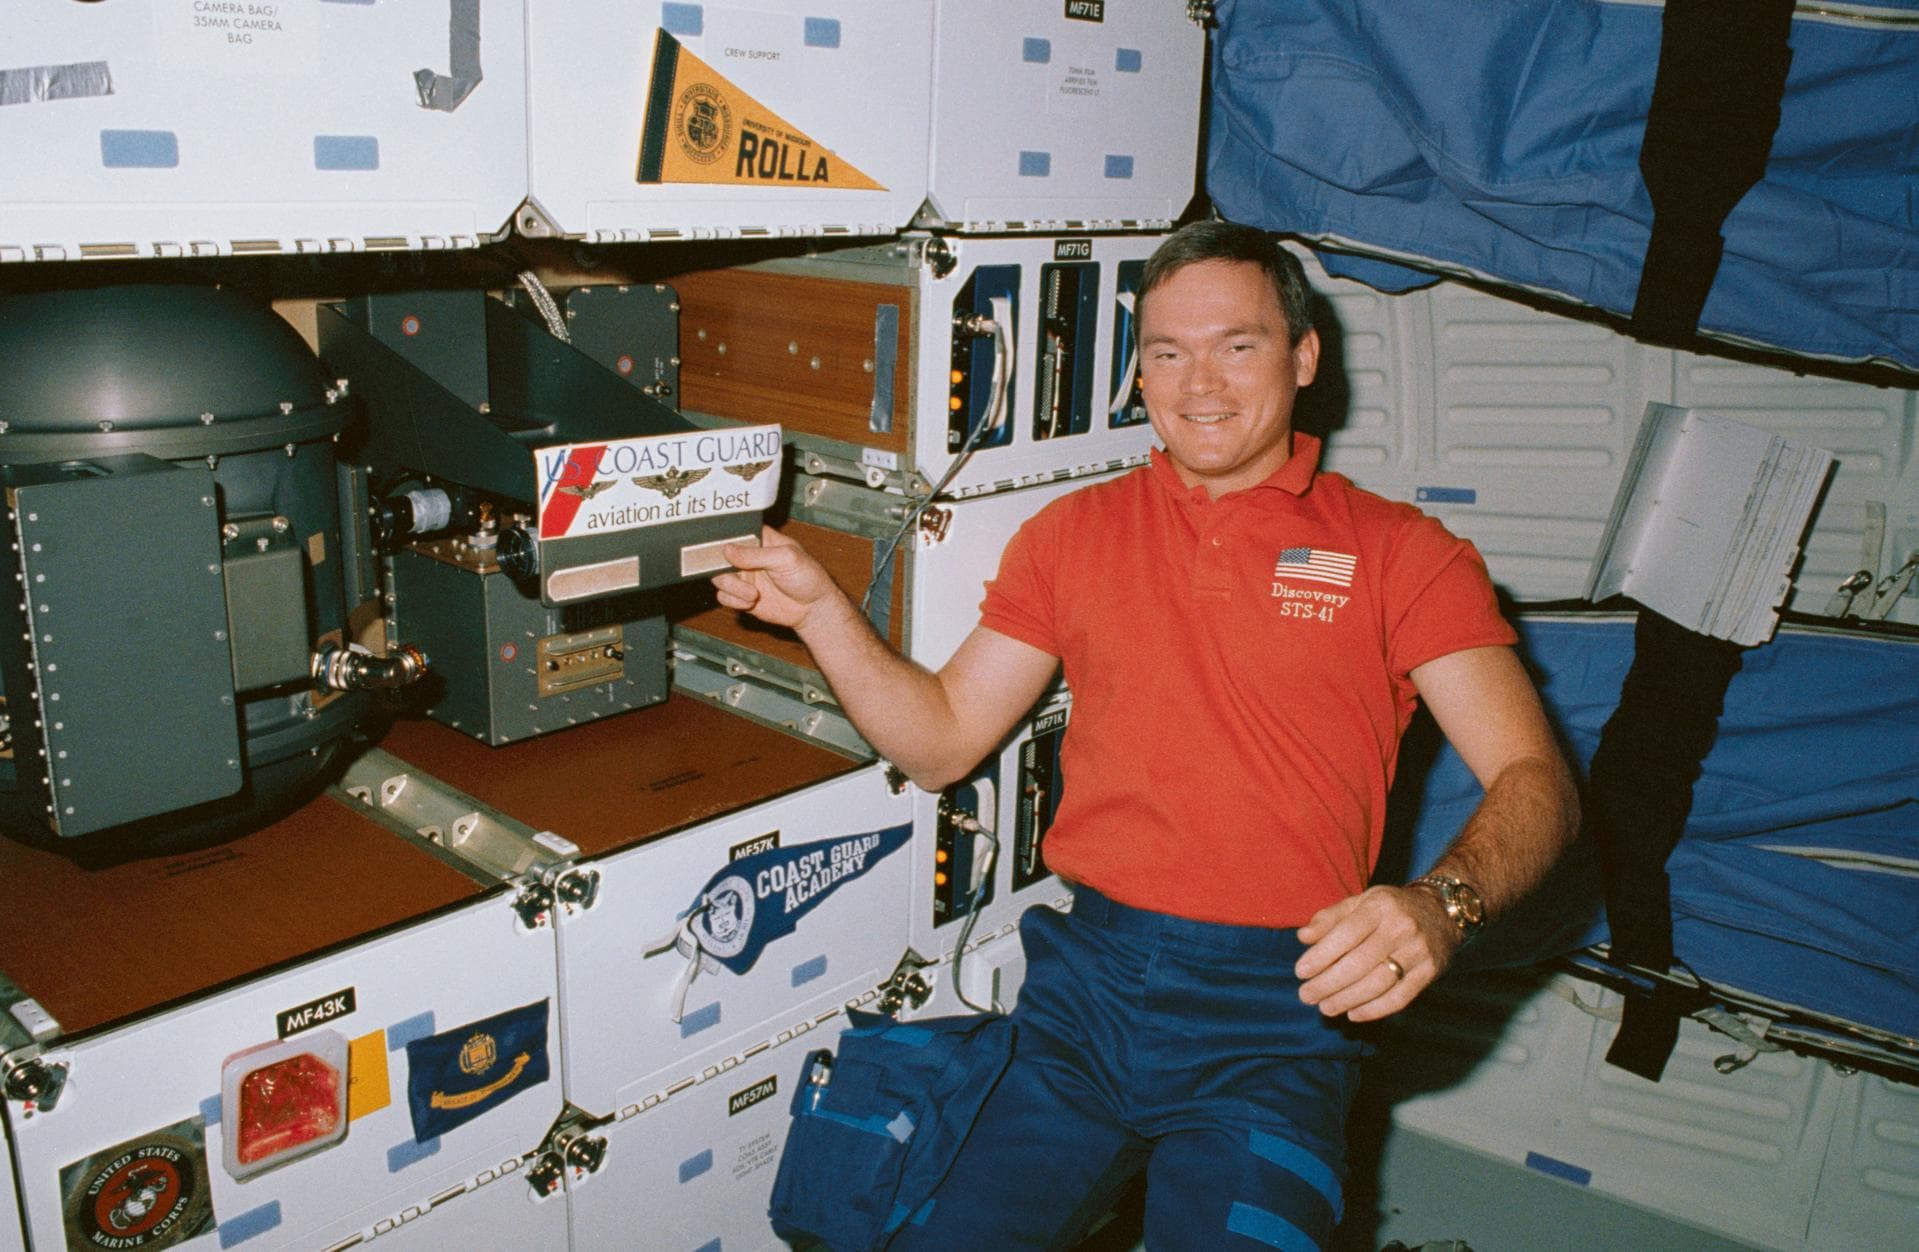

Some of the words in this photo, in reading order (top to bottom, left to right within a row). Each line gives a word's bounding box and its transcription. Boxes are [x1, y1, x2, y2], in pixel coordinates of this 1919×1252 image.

[194, 1, 244, 13] CAMERA
[248, 4, 278, 17] BAG/
[1069, 1, 1100, 17] MF71E
[194, 16, 230, 28] 35MM
[233, 18, 282, 31] CAMERA
[227, 32, 253, 44] BAG
[724, 47, 746, 58] CREW
[748, 49, 781, 61] SUPPORT
[736, 129, 829, 182] ROLLA
[1057, 243, 1089, 256] MF71G
[545, 449, 581, 482] US
[596, 440, 688, 475] COAST
[696, 430, 781, 463] GUARD
[587, 502, 660, 529] aviation
[665, 501, 681, 517] at
[687, 495, 706, 514] its
[712, 490, 751, 511] best
[1271, 582, 1350, 608] Discovery
[1280, 601, 1334, 623] STS-41
[735, 836, 774, 861] MF57K
[757, 850, 824, 899] COAST
[830, 833, 880, 864] GUARD
[784, 852, 867, 914] ACADEMY
[286, 996, 347, 1032] MF43K
[732, 1081, 774, 1111] MF57M
[88, 1155, 132, 1195] UNITED
[138, 1147, 181, 1162] STATES
[92, 1231, 144, 1248] MARINE
[152, 1196, 188, 1236] CORPS
